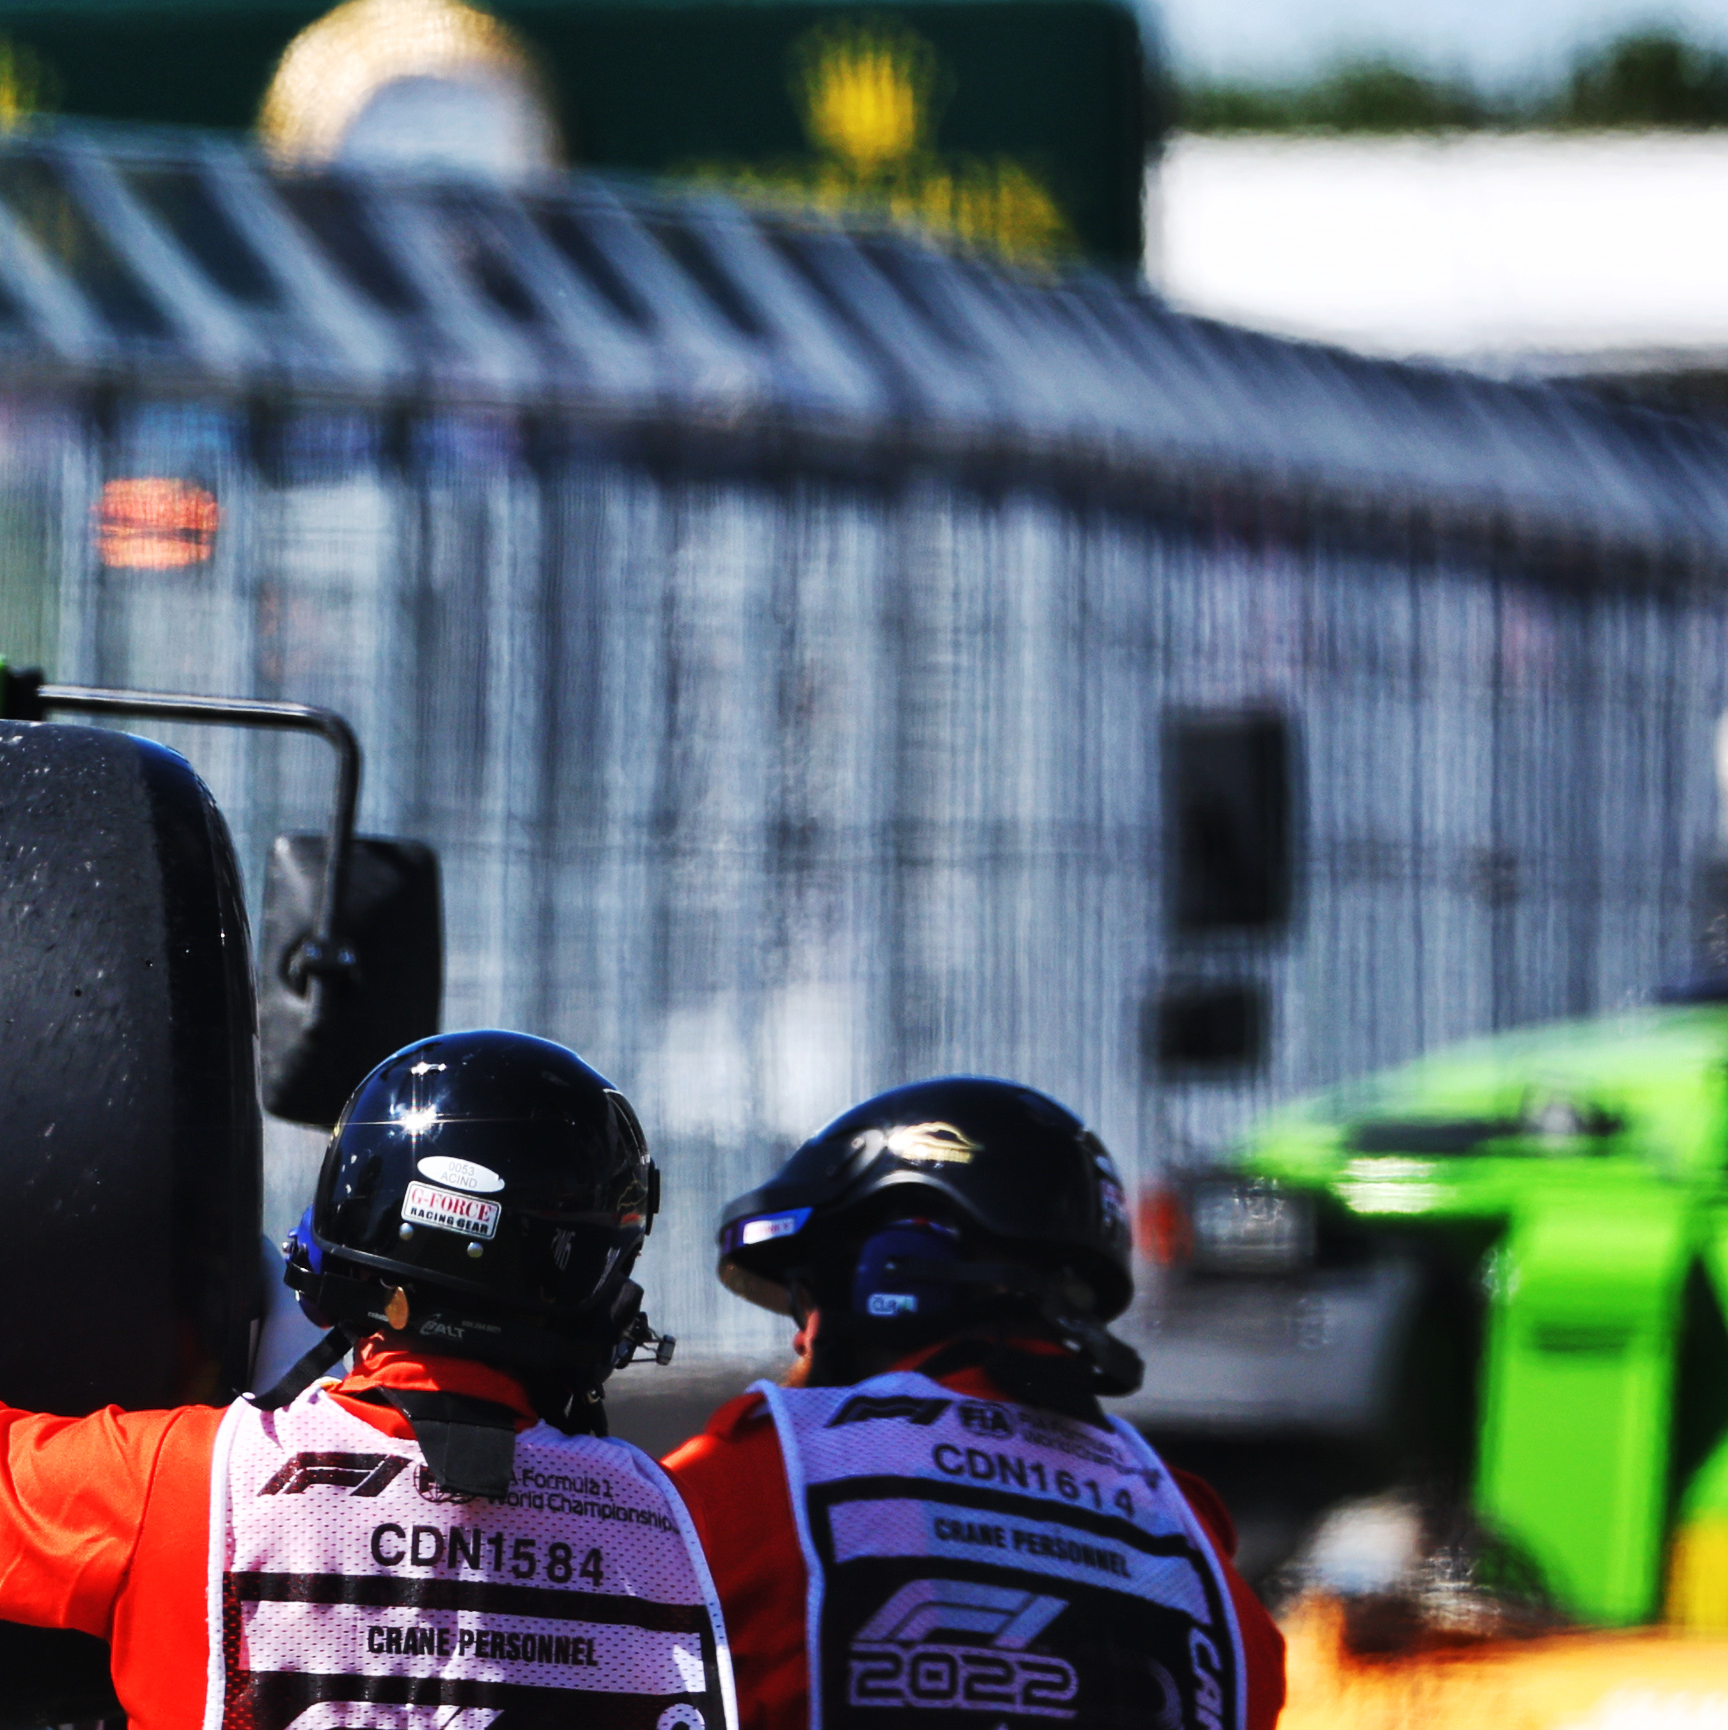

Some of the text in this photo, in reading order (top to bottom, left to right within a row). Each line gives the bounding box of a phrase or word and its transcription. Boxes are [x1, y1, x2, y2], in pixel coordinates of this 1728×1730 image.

[440, 1171, 478, 1189] ACIND
[448, 1161, 475, 1176] 0053
[410, 1207, 489, 1235] RACING GEAR
[411, 1187, 492, 1222] G-FORCE
[522, 1468, 601, 1495] Formula
[932, 1443, 1136, 1518] CDN1614
[371, 1523, 605, 1587] CDN1584
[933, 1517, 1132, 1579] CRANE PERSONNEL
[368, 1625, 599, 1668] CRANE PERSONNEL
[848, 1641, 1080, 1720] 2022
